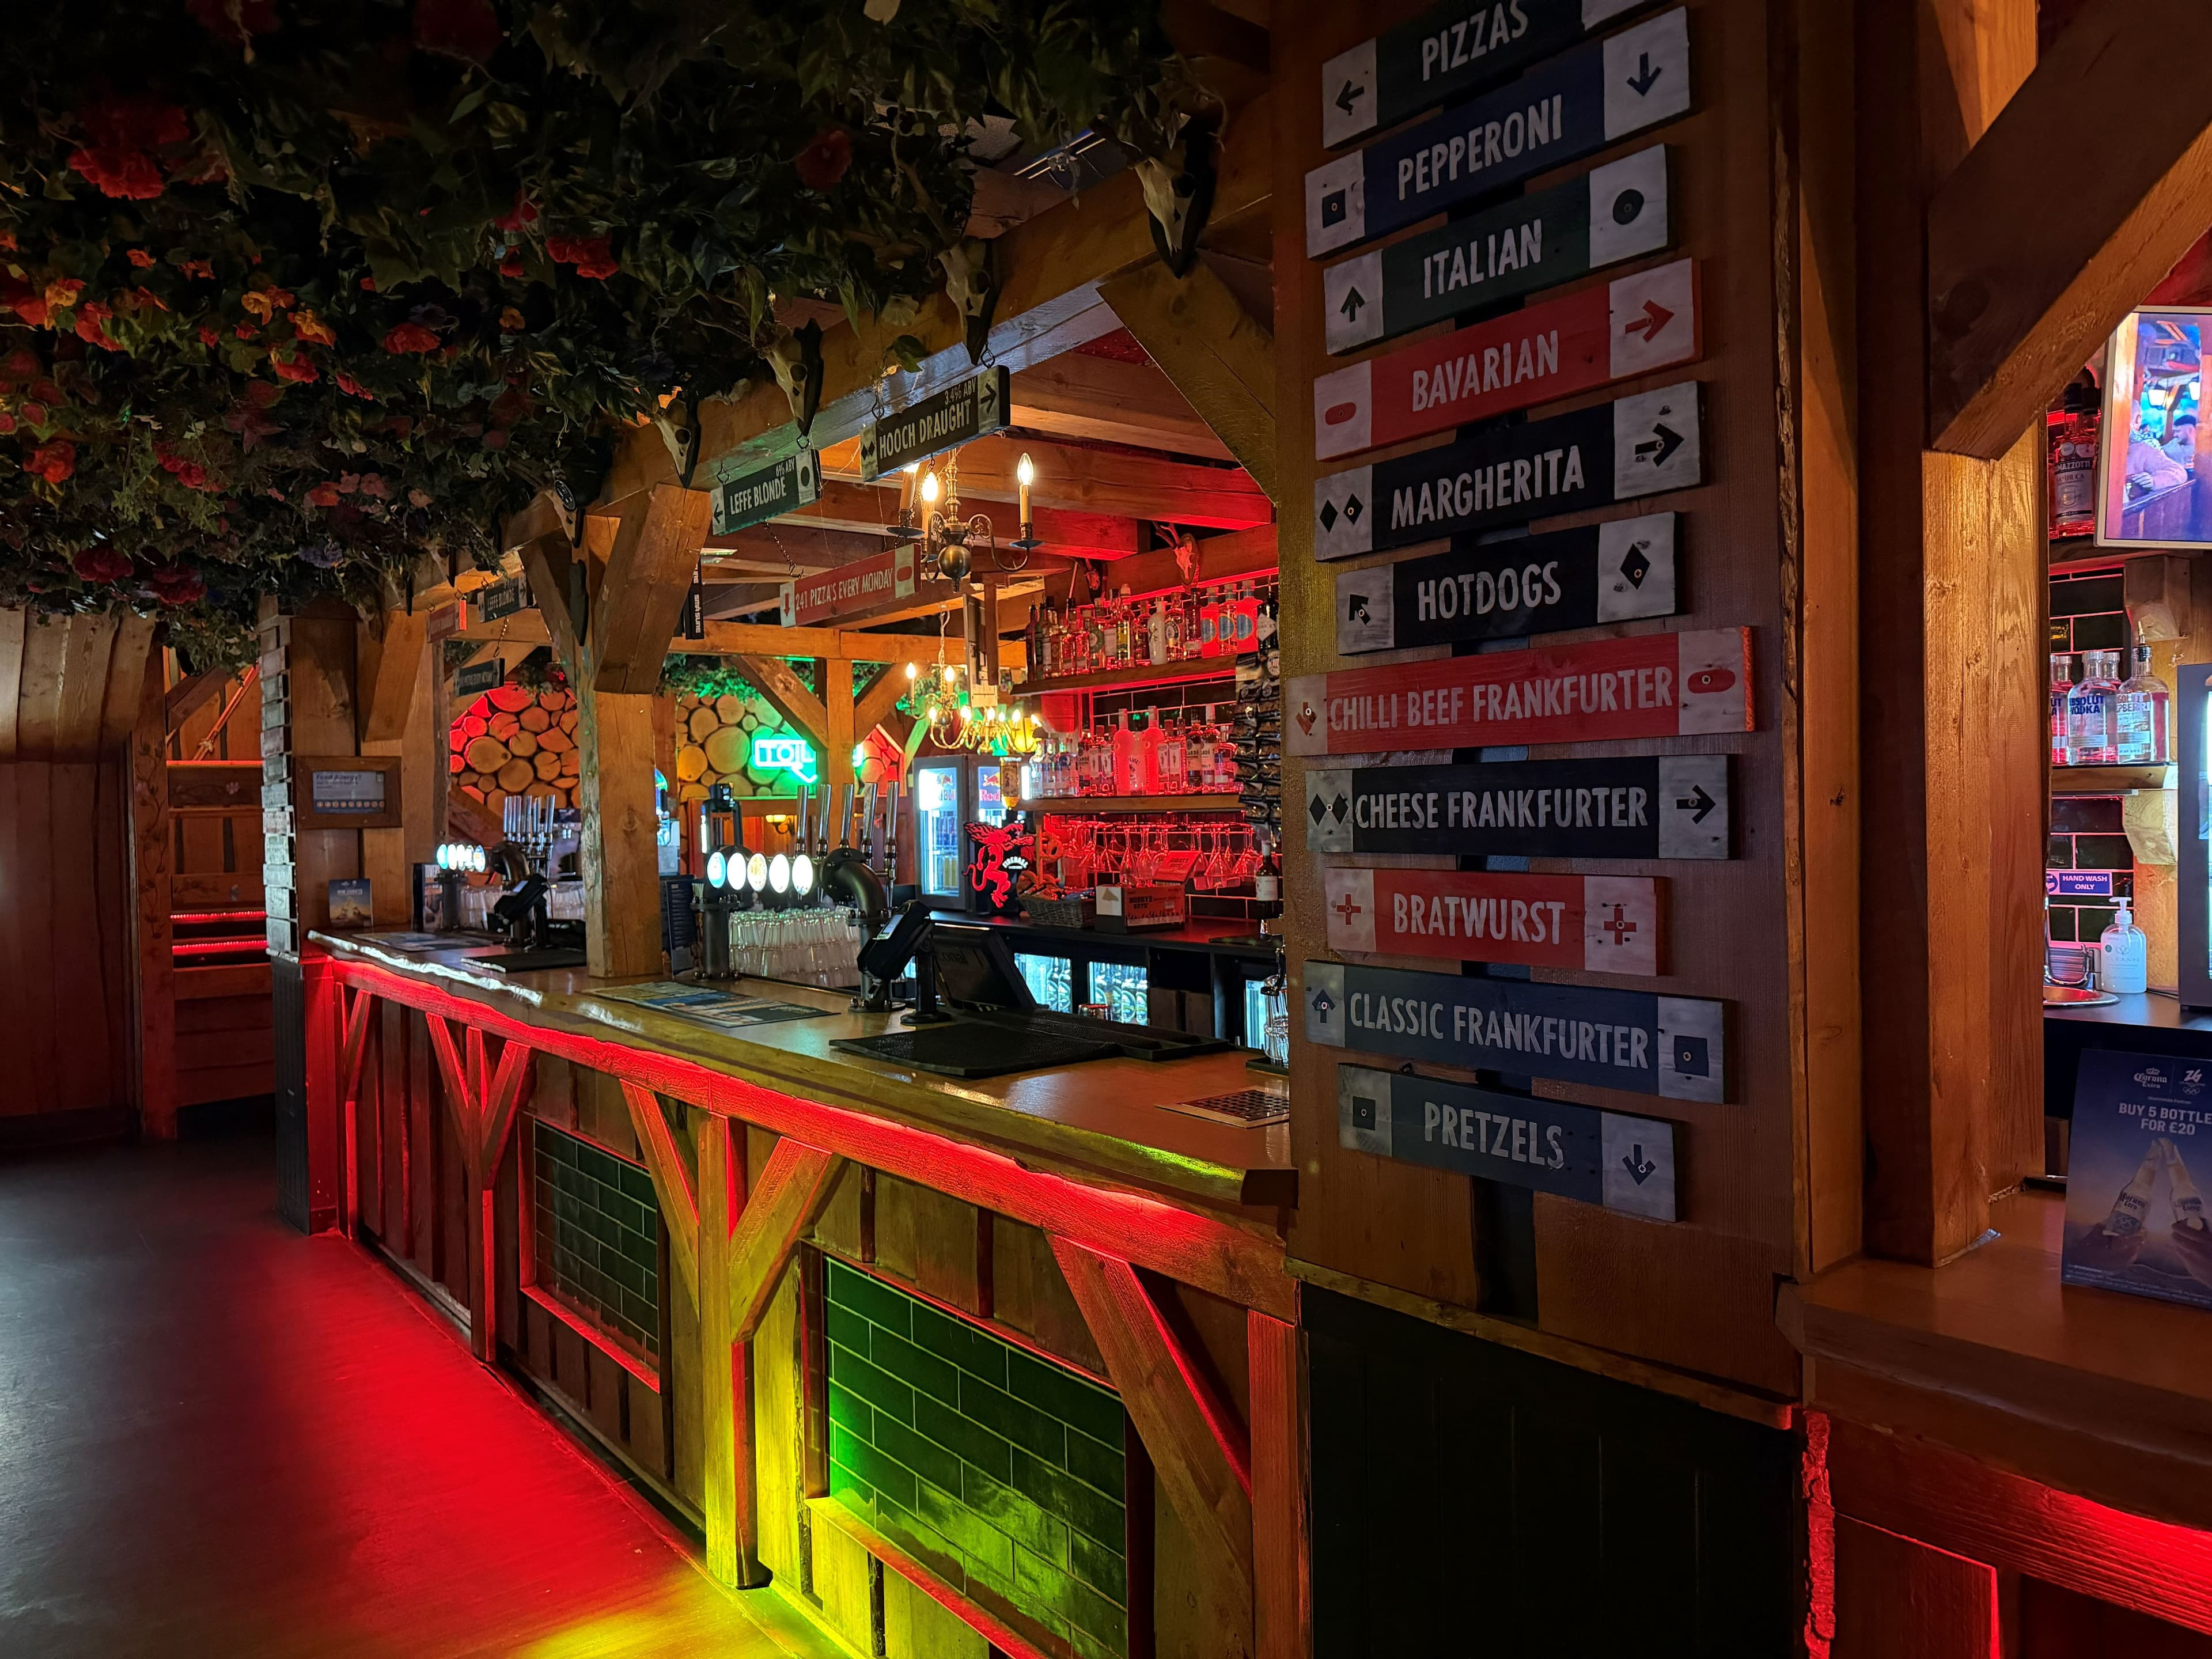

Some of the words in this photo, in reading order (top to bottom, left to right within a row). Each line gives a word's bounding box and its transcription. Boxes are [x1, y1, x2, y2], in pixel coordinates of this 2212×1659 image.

[1422, 0, 1529, 81] PIZZAS
[1397, 93, 1563, 201] PEPPERONI
[1423, 218, 1543, 299] ITALIAN
[944, 385, 961, 406] 3.4%
[963, 377, 978, 398] ABV
[1411, 329, 1559, 412] BAVARIAN
[878, 426, 916, 459] HOOCH
[920, 399, 972, 444] DRAUGHT
[730, 488, 752, 516] LEFFE
[753, 476, 787, 506] BLONDE
[775, 463, 785, 478] 6%
[785, 458, 796, 474] ABV
[1391, 445, 1585, 530] MARGHERITA
[810, 582, 838, 608] PIZZA'S
[838, 575, 860, 599] EVERY
[861, 567, 894, 594] MONDAY
[1418, 561, 1562, 621] HOTDOGS
[1330, 694, 1399, 731] CHILLI
[1407, 687, 1464, 728] BEEF
[1472, 666, 1674, 722] FRANKFURTER
[980, 789, 1001, 801] Red
[1355, 792, 1440, 830] CHEESE
[1448, 787, 1649, 829] FRANKFURTER
[1393, 892, 1566, 945] BRATWURST
[1349, 992, 1445, 1040] CLASSIC
[1453, 1005, 1650, 1070] FRANKFURTER
[2133, 1072, 2168, 1084] Corona
[1423, 1101, 1565, 1170] PRETZELS
[2118, 1102, 2146, 1117] BUY
[2147, 1106, 2157, 1118] 5
[2160, 1107, 2212, 1125] BOTTLE
[2141, 1118, 2166, 1132] FOR
[2169, 1122, 2196, 1135] £20
